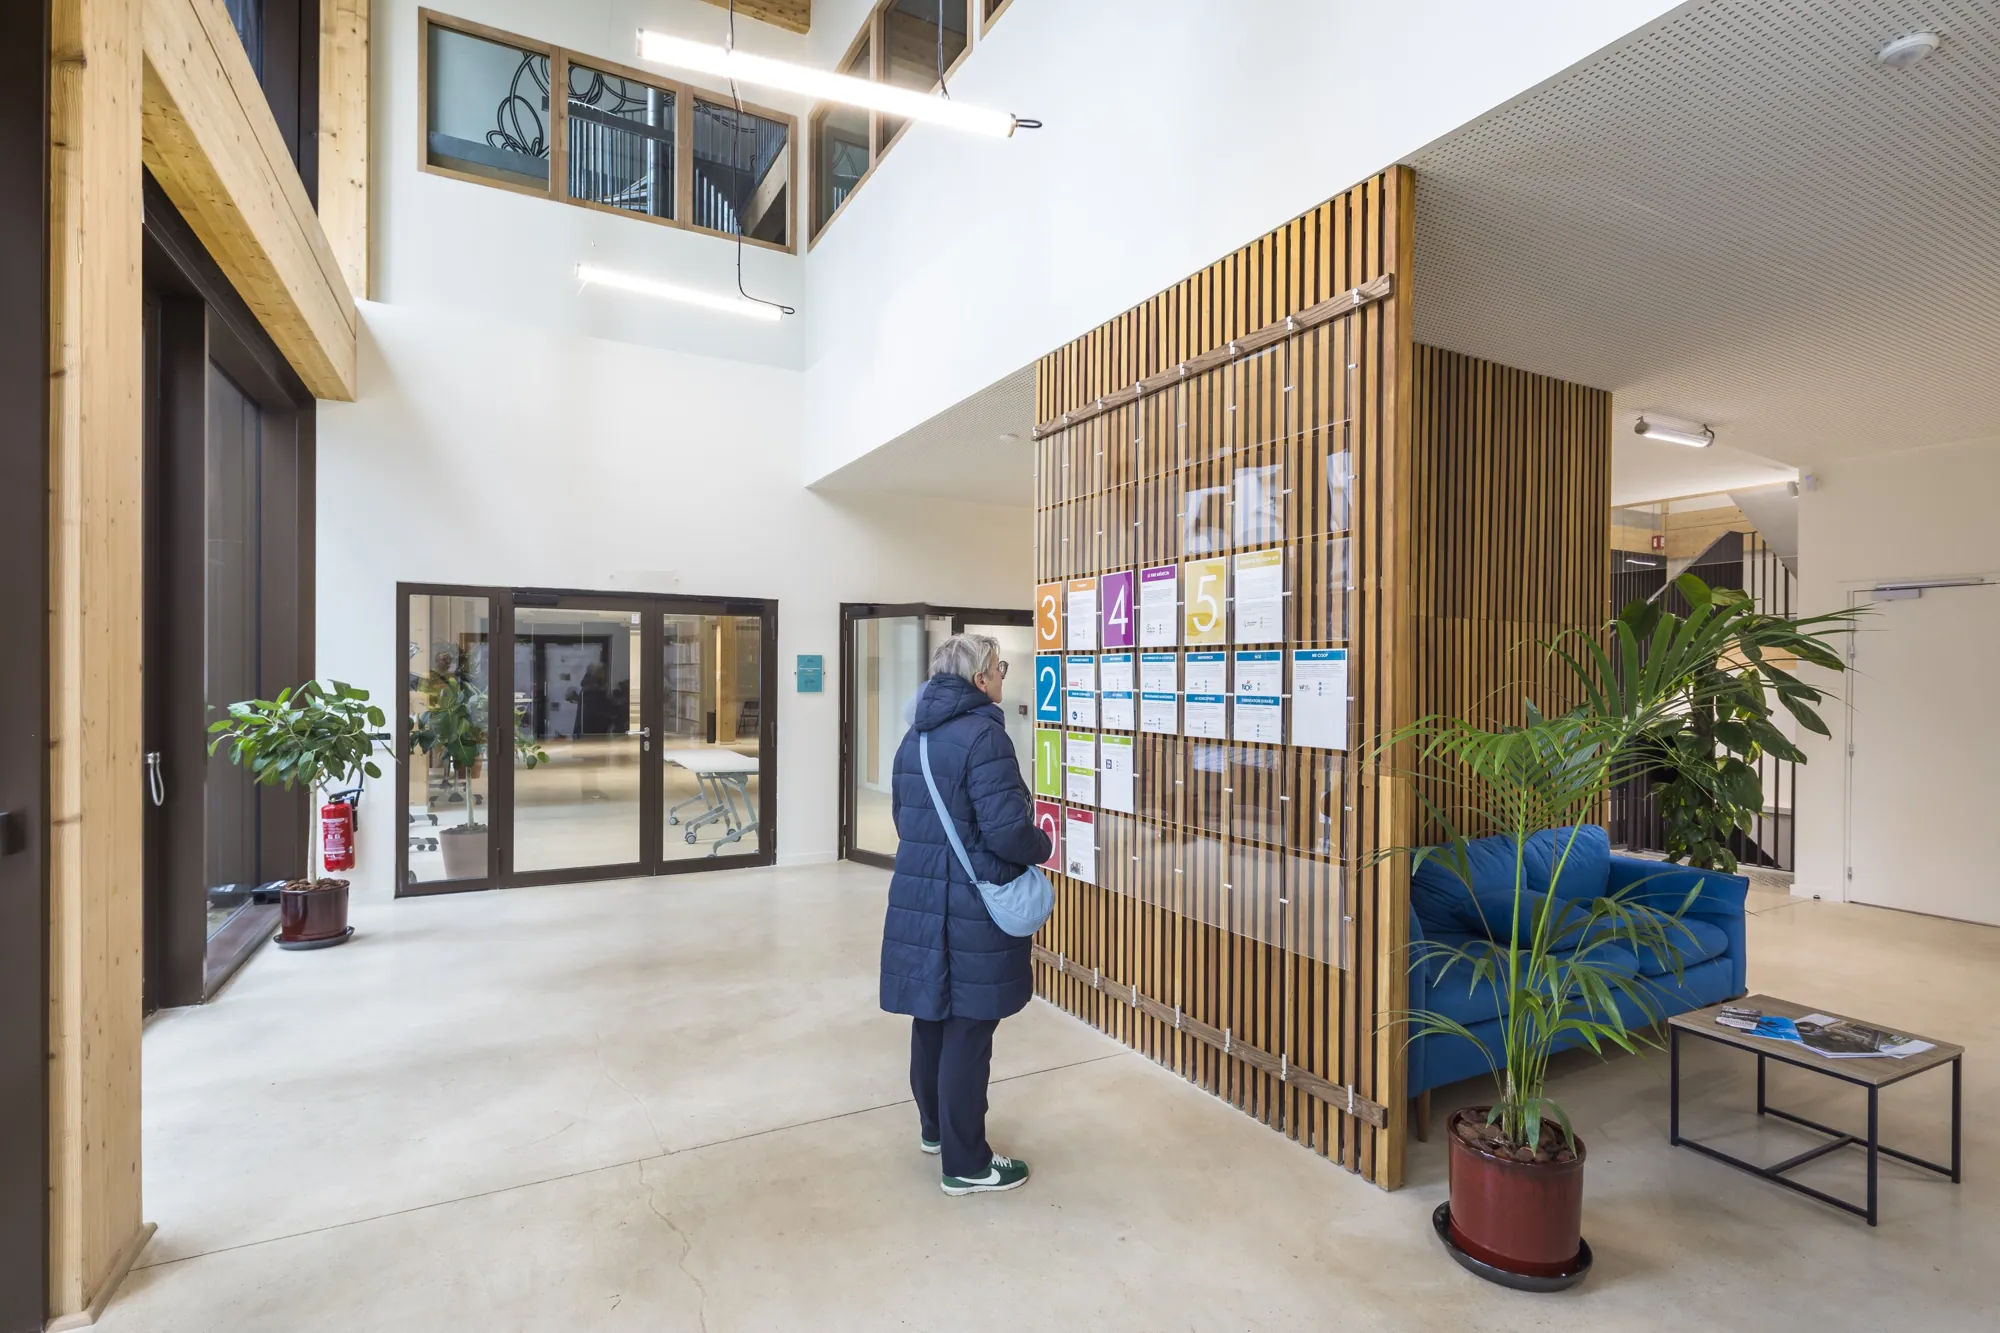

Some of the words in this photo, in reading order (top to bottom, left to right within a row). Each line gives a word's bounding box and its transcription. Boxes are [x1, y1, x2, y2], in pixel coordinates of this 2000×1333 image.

[1041, 594, 1058, 641] 3
[1108, 584, 1129, 635] 4
[1192, 574, 1218, 632] 5
[1040, 666, 1058, 711] 2
[1043, 741, 1051, 785] 1
